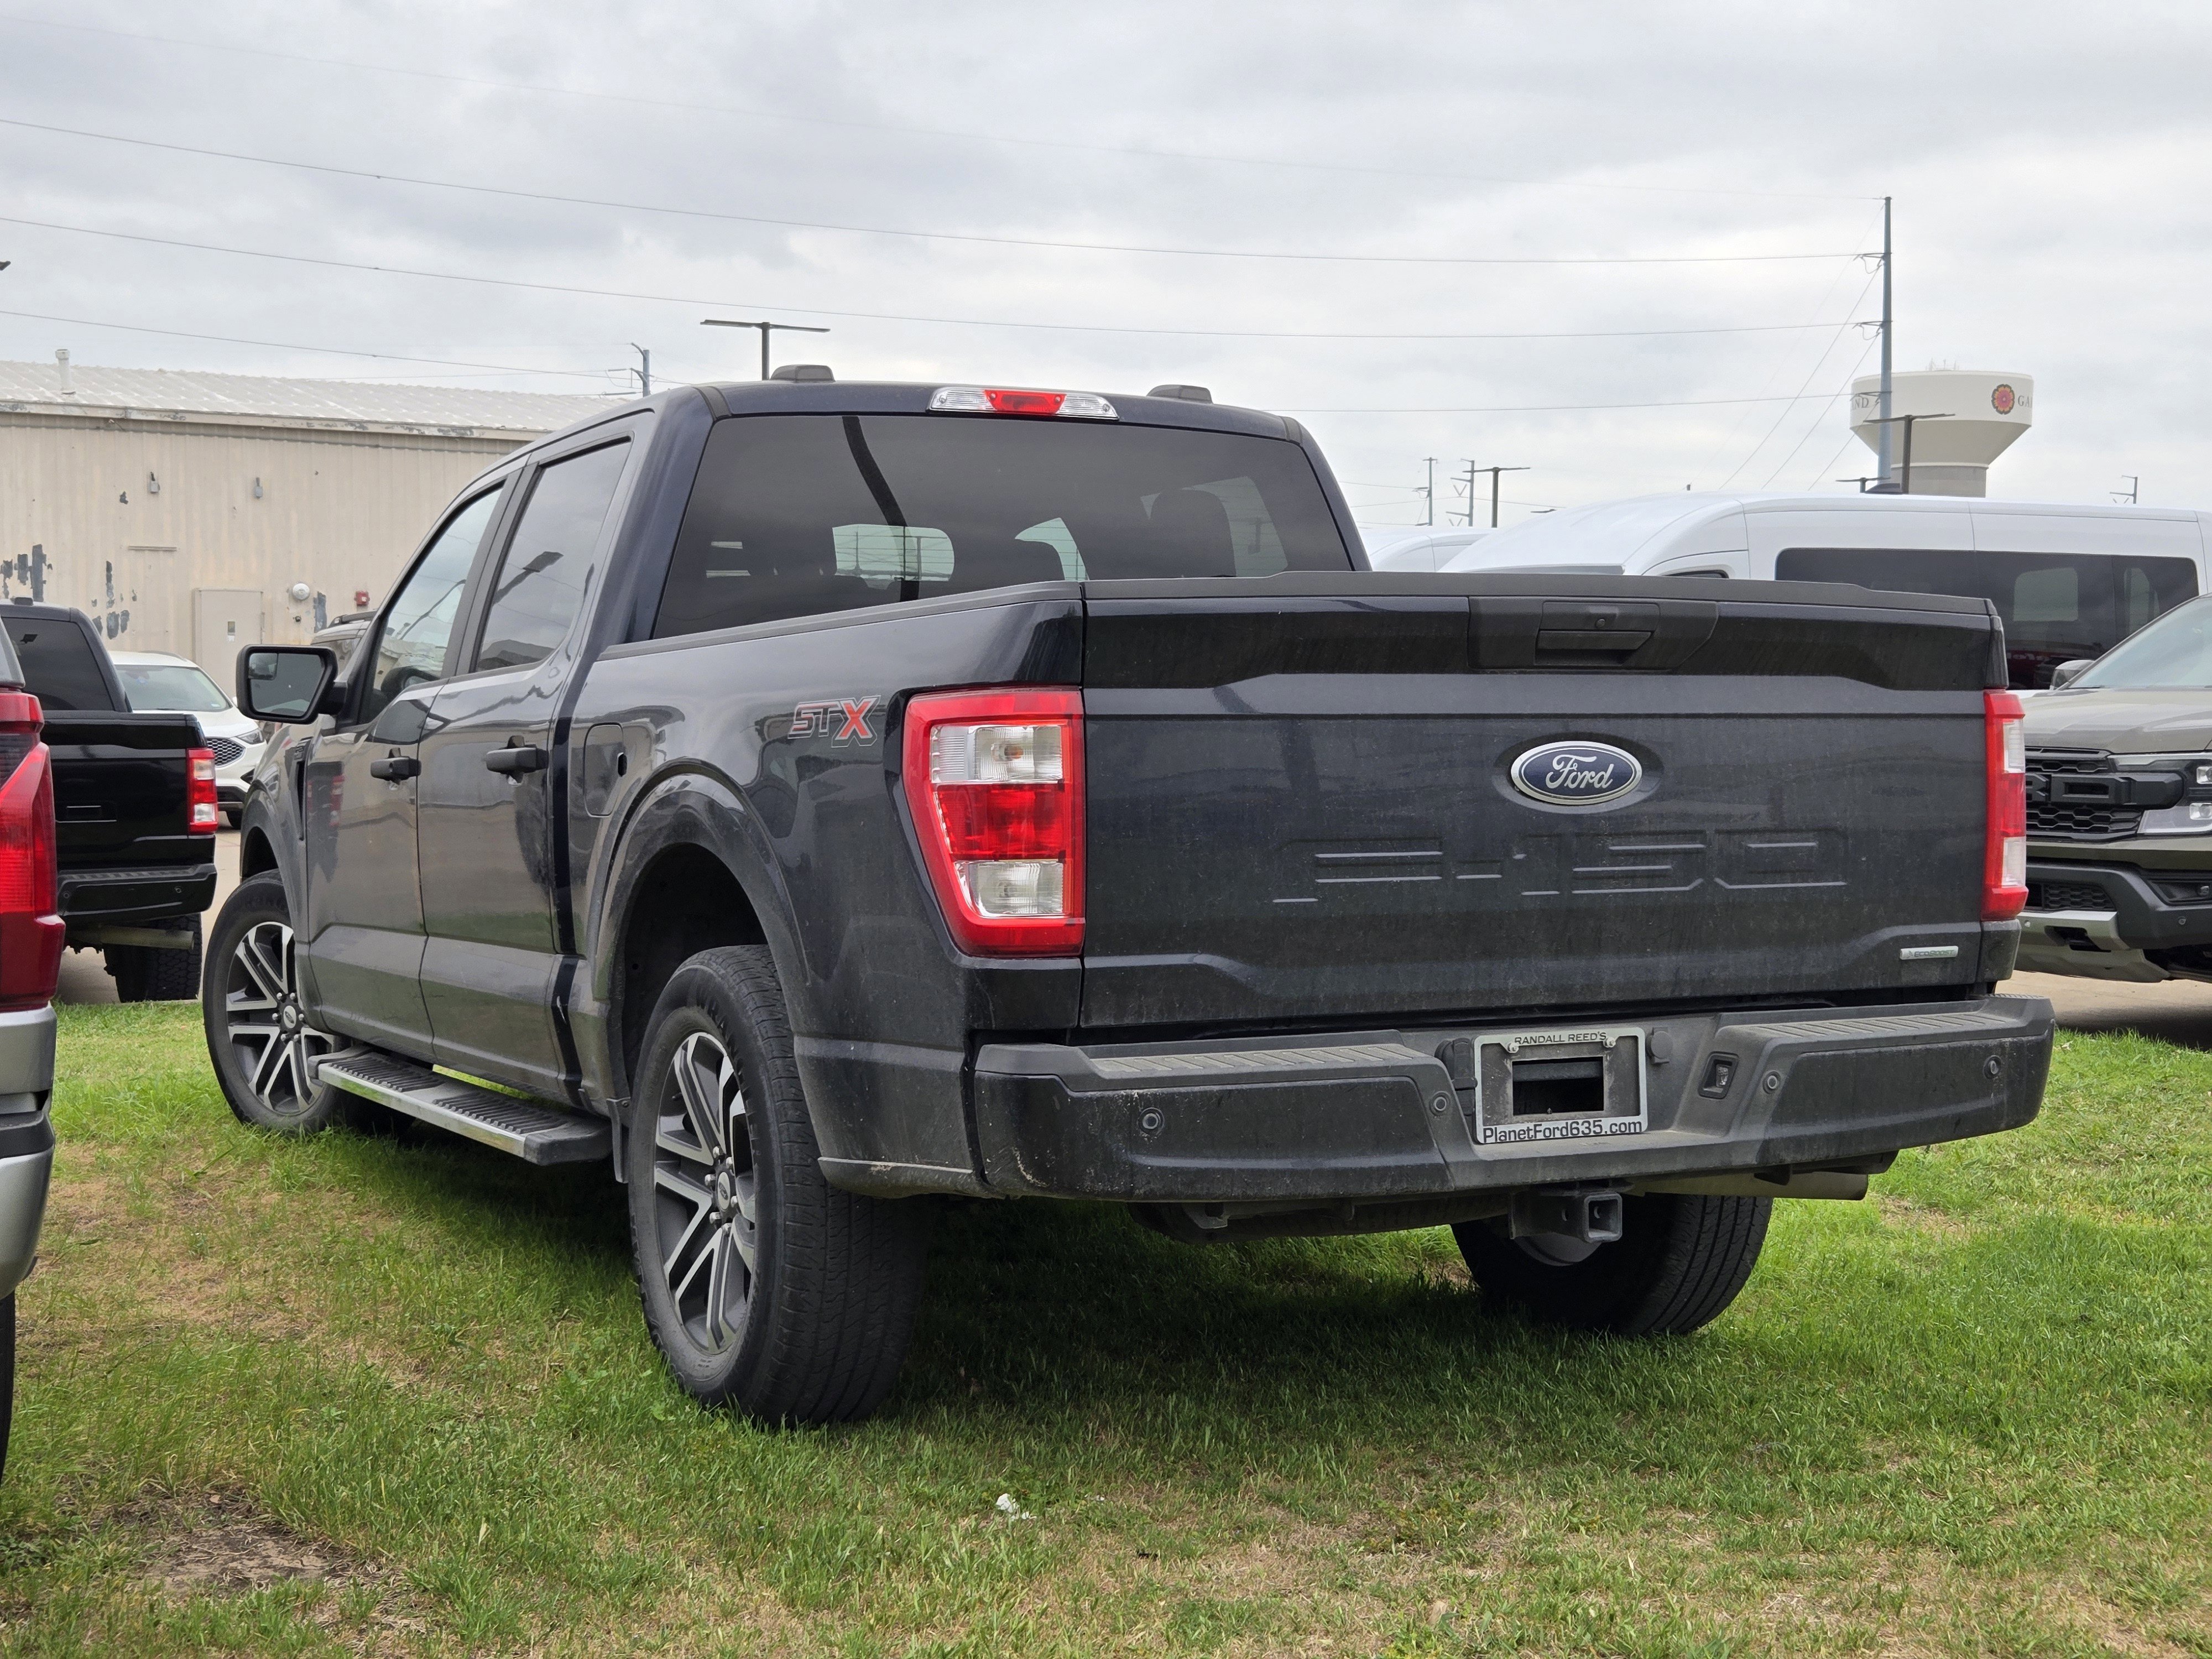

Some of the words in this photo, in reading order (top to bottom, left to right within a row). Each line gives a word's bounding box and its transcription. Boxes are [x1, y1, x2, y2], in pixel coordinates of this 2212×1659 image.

[1853, 397, 1870, 410] ND
[787, 695, 881, 748] STX
[1545, 754, 1614, 789] Ford
[1514, 1034, 1565, 1045] RANDALL
[1568, 1031, 1606, 1042] REED'S
[1483, 1119, 1642, 1143] PlanetFord635.com
